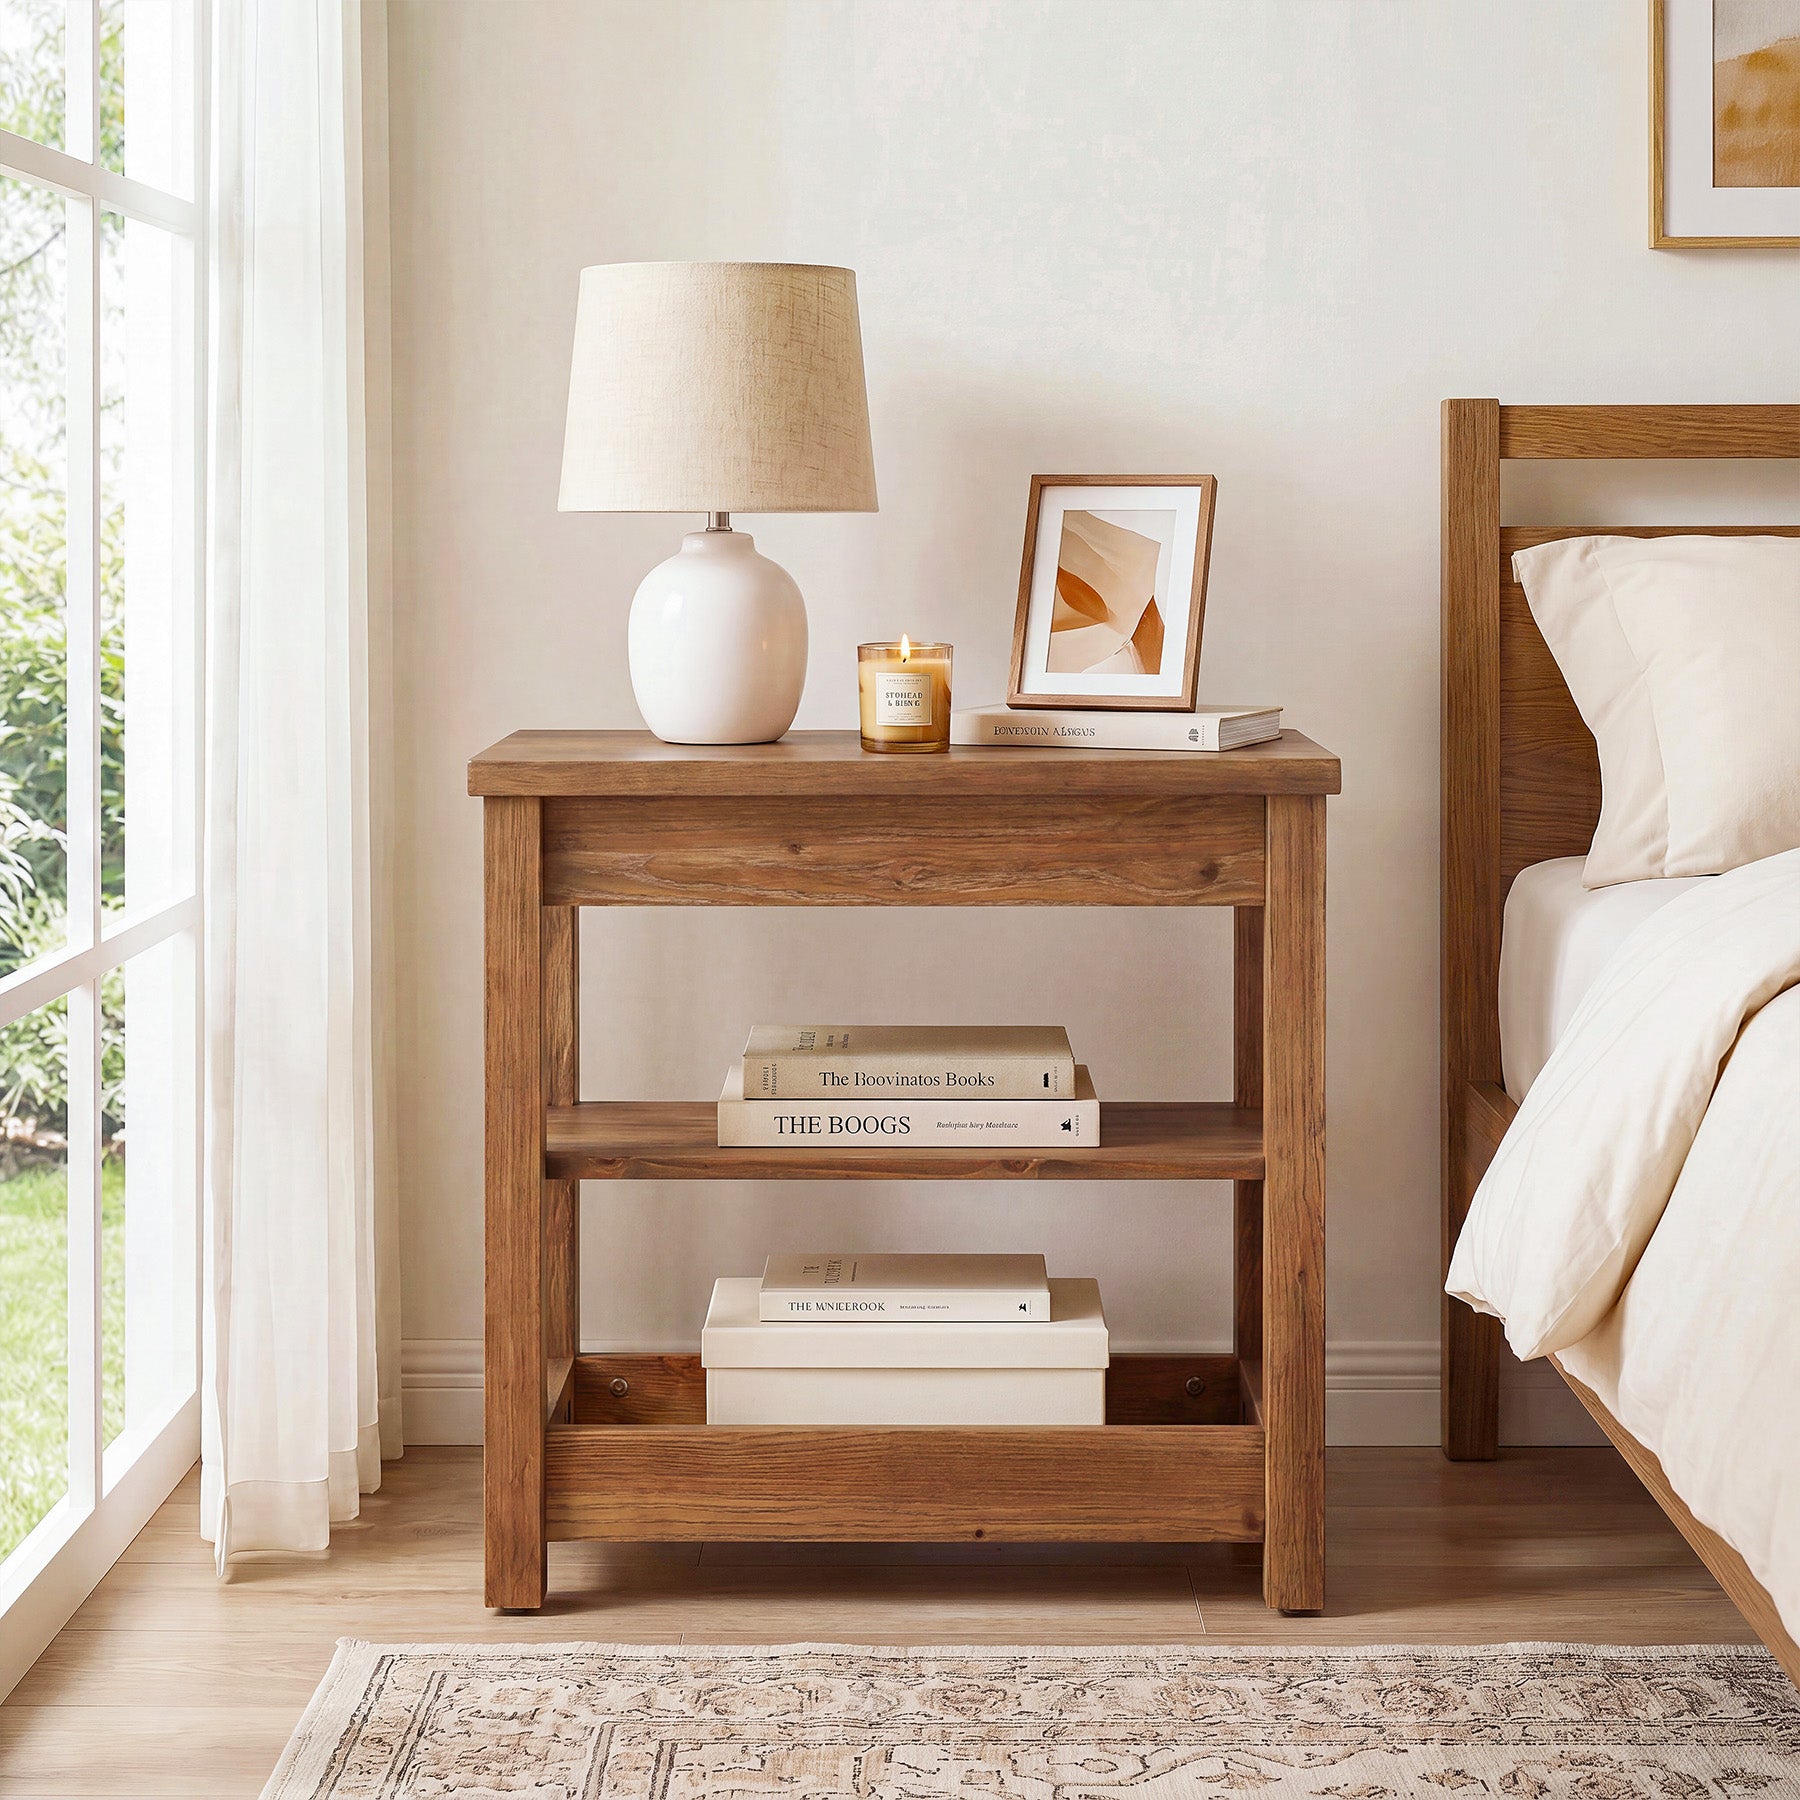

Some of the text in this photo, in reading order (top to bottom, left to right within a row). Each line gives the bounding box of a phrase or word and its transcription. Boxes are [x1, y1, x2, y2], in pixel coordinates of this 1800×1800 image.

[818, 1071, 849, 1087] The
[945, 1071, 995, 1087] Books
[773, 1115, 911, 1135] THE BOOGS
[788, 1301, 812, 1311] THE
